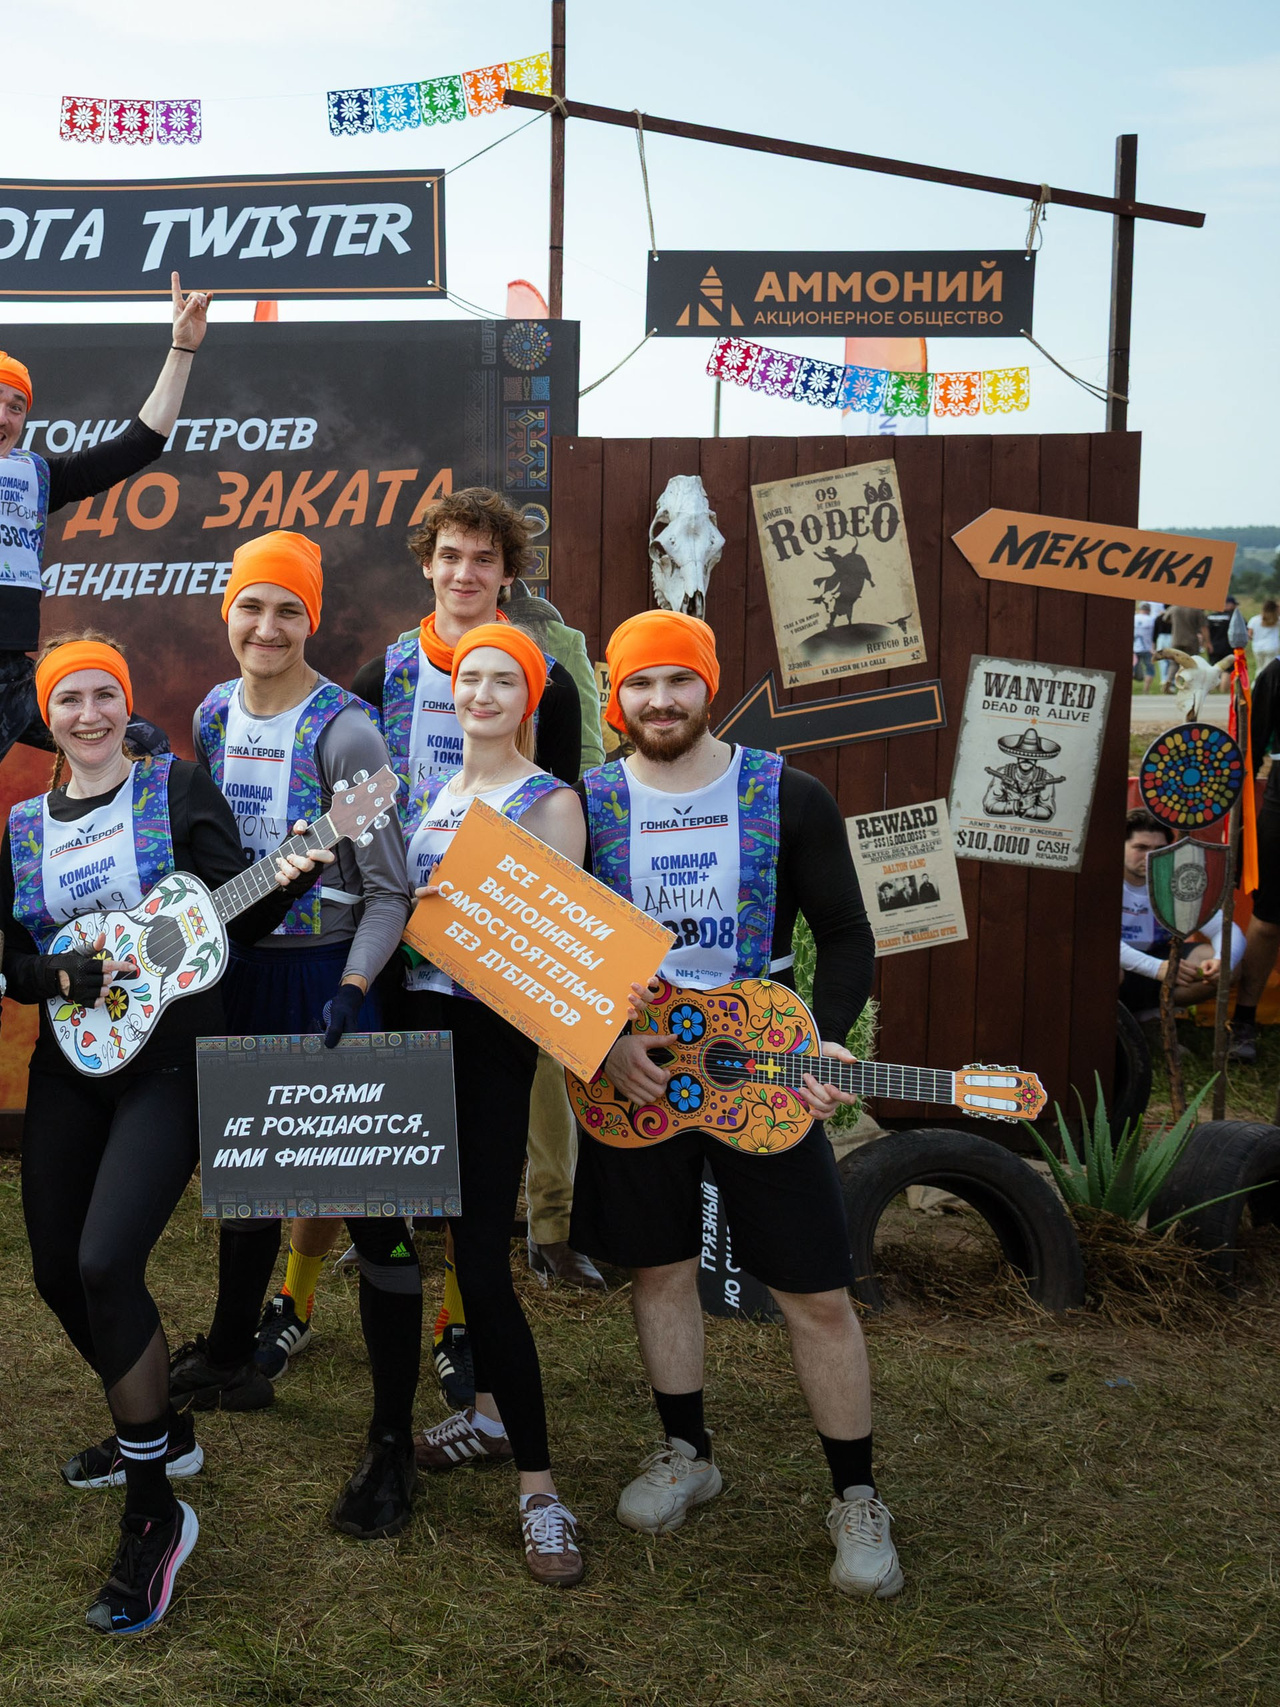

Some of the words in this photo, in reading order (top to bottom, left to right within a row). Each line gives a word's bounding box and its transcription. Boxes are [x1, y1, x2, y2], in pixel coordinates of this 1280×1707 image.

[142, 203, 412, 272] TWISTER
[754, 261, 1003, 303] АММОНИЙ
[753, 310, 894, 327] АКЦИОНЕРНОЕ
[899, 310, 1003, 327] ОБЩЕСТВО
[163, 418, 318, 452] ГЕРОЕВ
[62, 472, 180, 540] ДО
[815, 486, 837, 502] 09
[765, 502, 900, 561] RODEO
[988, 525, 1213, 589] МЕКСИКА
[867, 638, 899, 654] REFUGIO
[903, 635, 919, 647] BAR
[869, 658, 886, 667] CALLE
[983, 671, 1096, 709] WANTED
[422, 700, 456, 711] ГОНКА
[982, 700, 1018, 714] DEAD
[1024, 704, 1040, 716] OR
[1047, 708, 1090, 723] ALIVE
[252, 747, 285, 758] ГЕРОЕВ
[225, 783, 273, 802] КОМАНДА
[230, 800, 266, 816] 10КМ+
[640, 818, 679, 831] ГОНКА
[682, 814, 729, 828] ГЕРОЕВ
[855, 805, 938, 840] REWARD
[50, 838, 82, 856] ГОНКА
[85, 823, 124, 844] ГЕРОЕВ
[956, 829, 1030, 856] $10,000
[1036, 840, 1070, 855] CASH
[651, 852, 717, 871] КОМАНДА
[1035, 852, 1068, 862] REWARD
[59, 856, 116, 888] КОМАНДА
[661, 871, 709, 887] 10КМ+
[69, 875, 110, 900] 10КМ+
[496, 854, 540, 889] ВСЕ
[538, 883, 615, 941] ТРЮКИ
[642, 886, 723, 917] ДАНИЛ
[478, 876, 605, 971] ВЫПОЛНЕНЫ
[662, 916, 735, 951] 3808
[444, 920, 482, 952] БЕЗ
[476, 948, 581, 1027] ДУБЛЕРОВ
[267, 1082, 385, 1105] ГЕРОЯМИ
[223, 1117, 255, 1137] НЕ
[213, 1147, 268, 1168] ИМИ
[274, 1145, 445, 1167] ФИНИШИРУЮТ
[700, 1181, 718, 1272] ГРЯЗНЫЙ
[724, 1279, 741, 1309] НО
